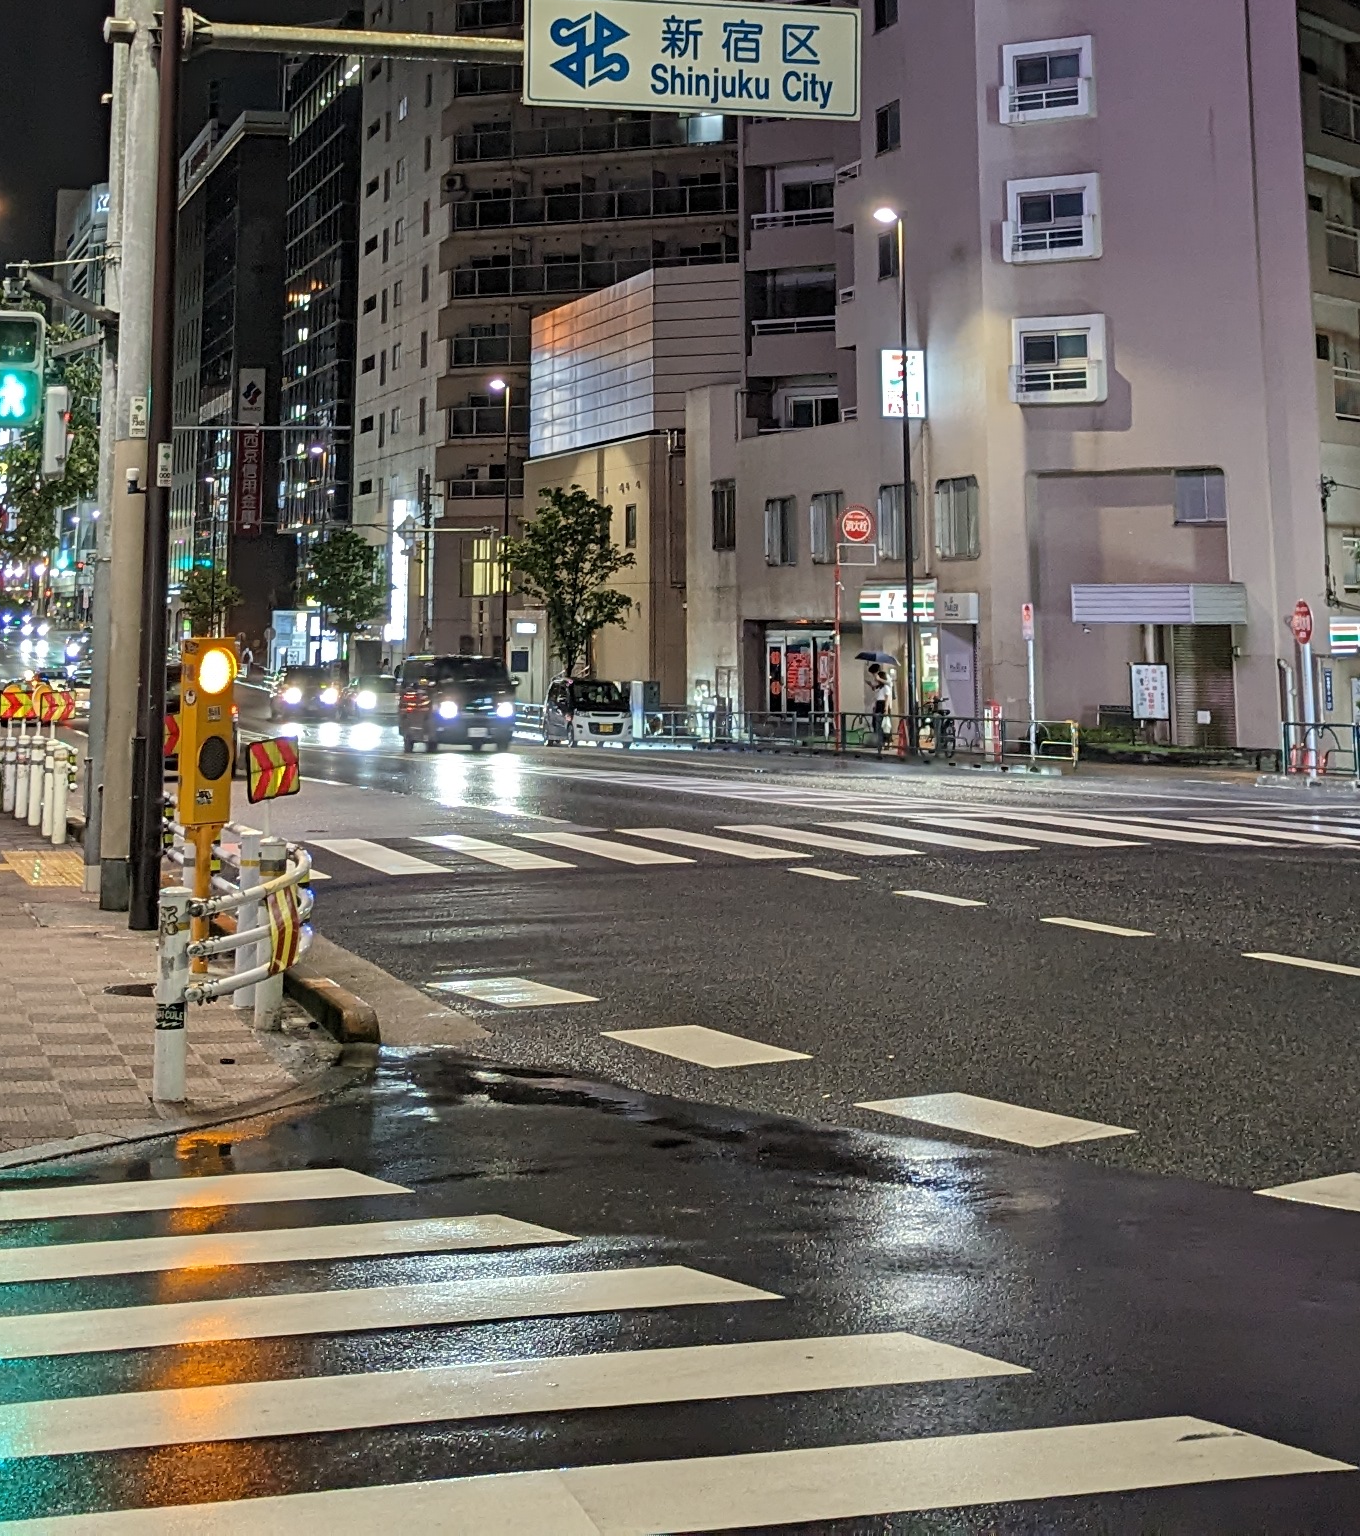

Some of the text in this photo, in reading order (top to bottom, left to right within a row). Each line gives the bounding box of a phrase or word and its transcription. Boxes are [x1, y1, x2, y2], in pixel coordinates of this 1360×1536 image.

[661, 15, 820, 65] 新宿区
[650, 64, 833, 109] Shinjuku City
